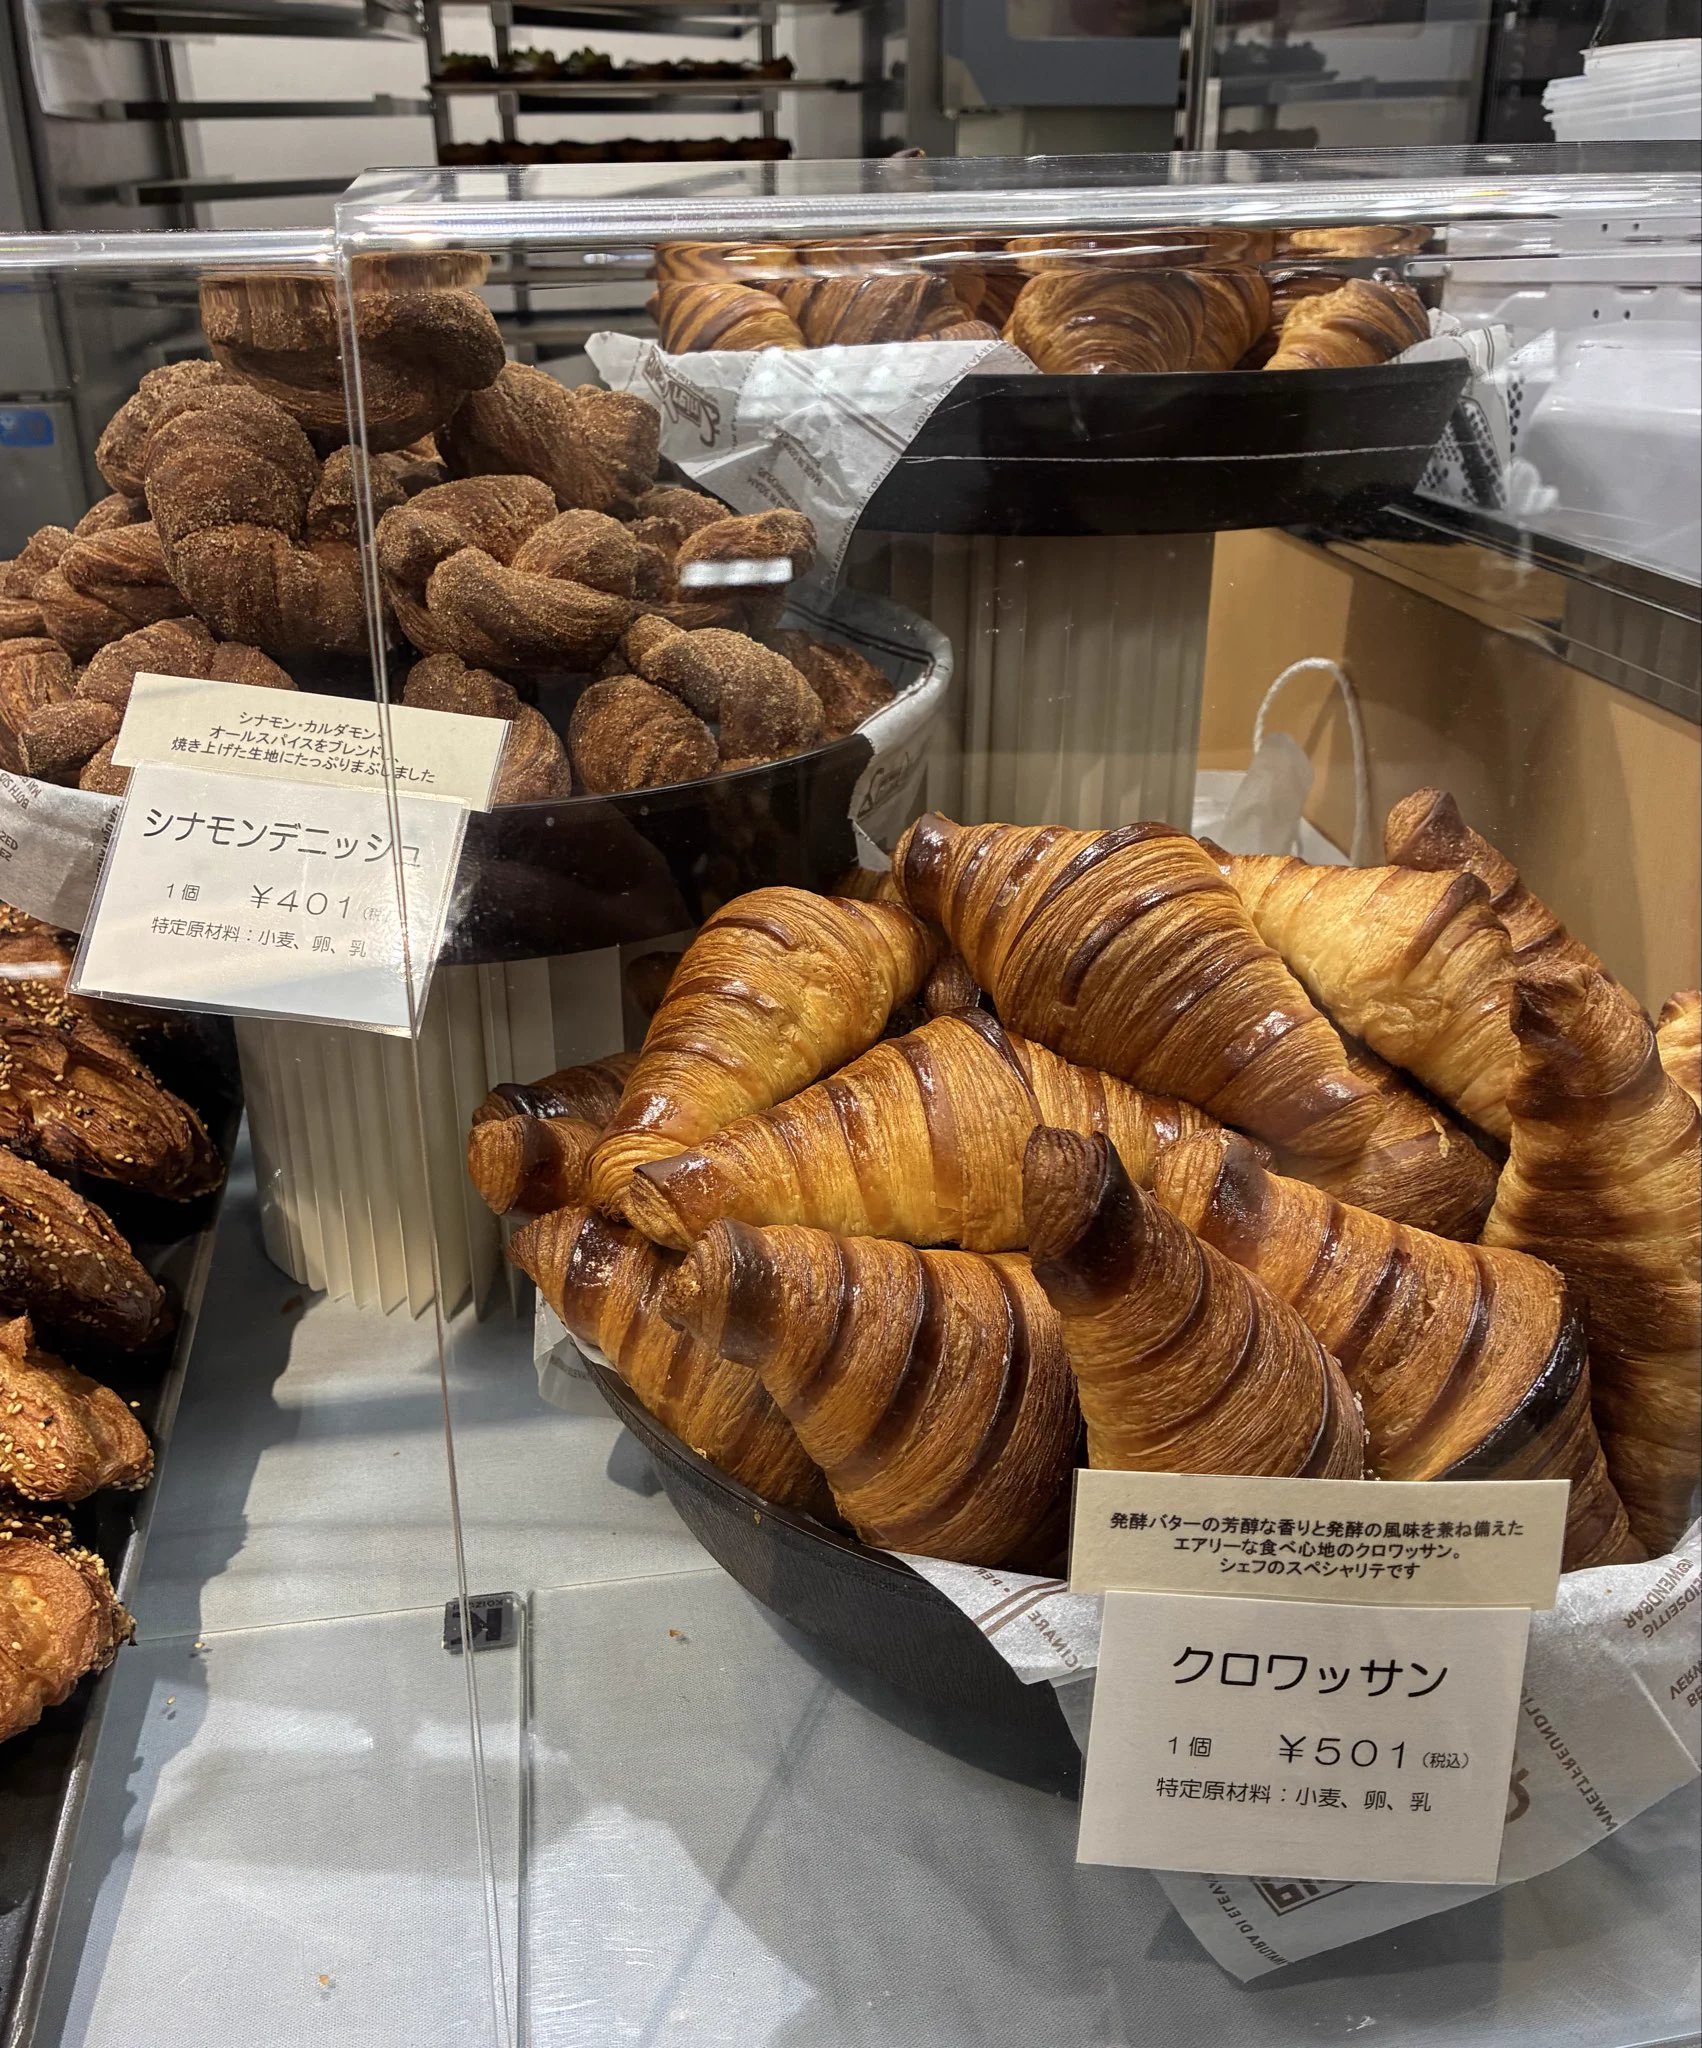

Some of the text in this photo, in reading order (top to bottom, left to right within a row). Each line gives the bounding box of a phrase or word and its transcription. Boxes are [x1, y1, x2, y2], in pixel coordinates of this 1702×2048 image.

[143, 808, 421, 867] シナモンデニッシュ
[250, 884, 351, 919] ¥401
[1110, 1512, 1524, 1539] 発酵バターの芳醇な香りと発酵の風味を兼ね備えた
[1174, 1537, 1461, 1560] エアリーな食べ心地のクロワッサン。
[1219, 1557, 1421, 1580] シェフのスペシャリテです
[1172, 1646, 1448, 1698] クロワッサン
[1279, 1734, 1406, 1769] ¥501
[1422, 1752, 1470, 1770] (税込)
[1156, 1776, 1432, 1812] 特定原材料：小麦、卵、乳
